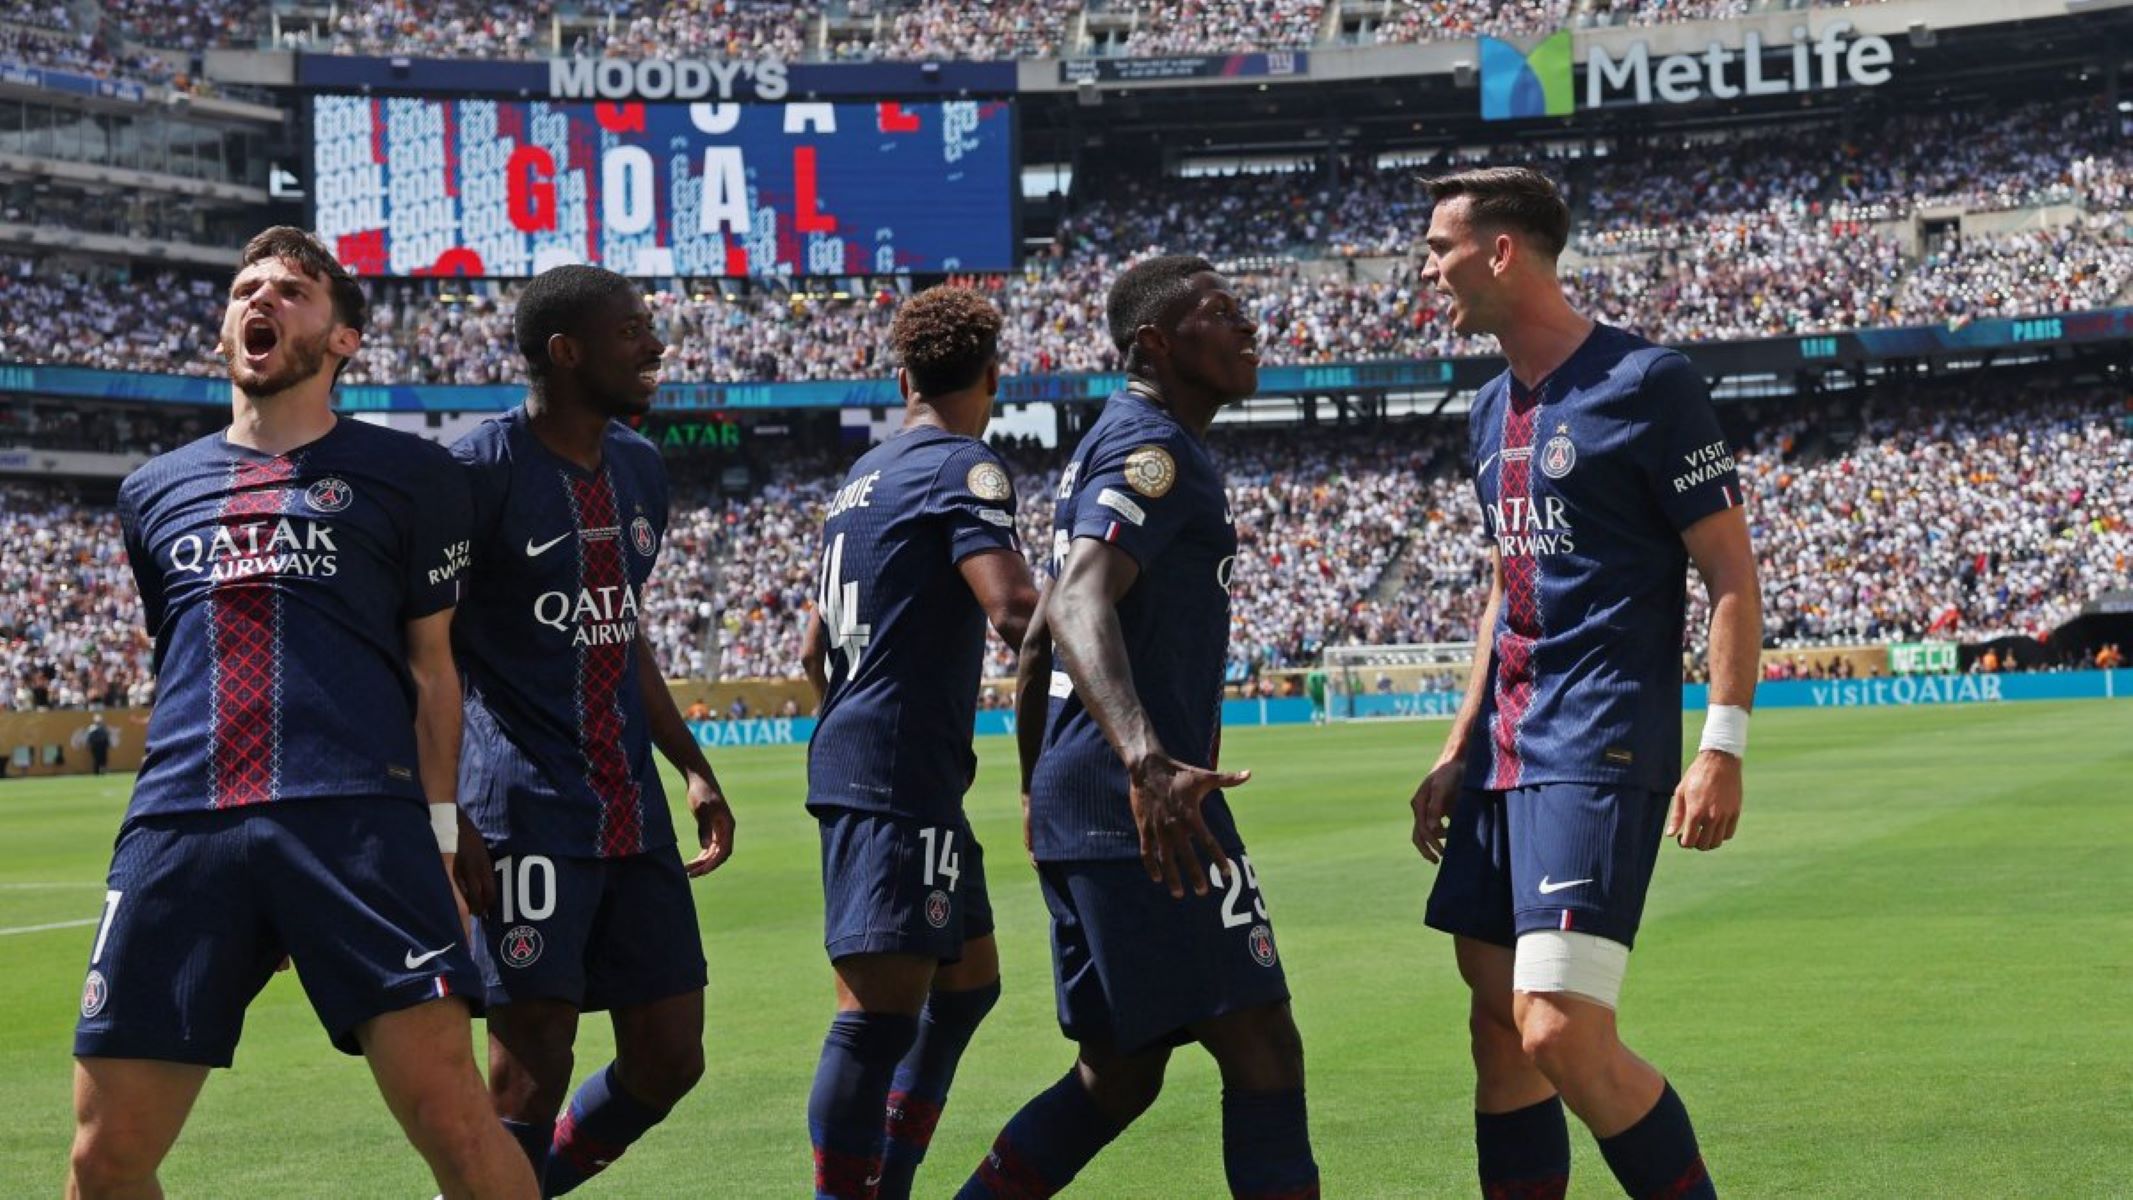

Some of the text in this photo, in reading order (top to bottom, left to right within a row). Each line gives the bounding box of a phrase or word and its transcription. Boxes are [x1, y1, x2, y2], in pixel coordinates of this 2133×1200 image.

[550, 58, 789, 100] MOODY'S
[1587, 22, 1894, 107] MetLife
[507, 144, 837, 235] GOAL
[1673, 454, 1735, 493] RWAND
[1684, 440, 1727, 467] VISIT
[170, 517, 338, 573] QATAR
[204, 554, 337, 582] AIRWAYS
[1500, 532, 1575, 558] IRWAYS
[534, 584, 638, 632] QATA
[689, 718, 794, 747] QATAR
[919, 827, 960, 892] 14
[495, 855, 557, 923] 10
[1209, 855, 1269, 928] 25
[92, 889, 123, 964] 7
